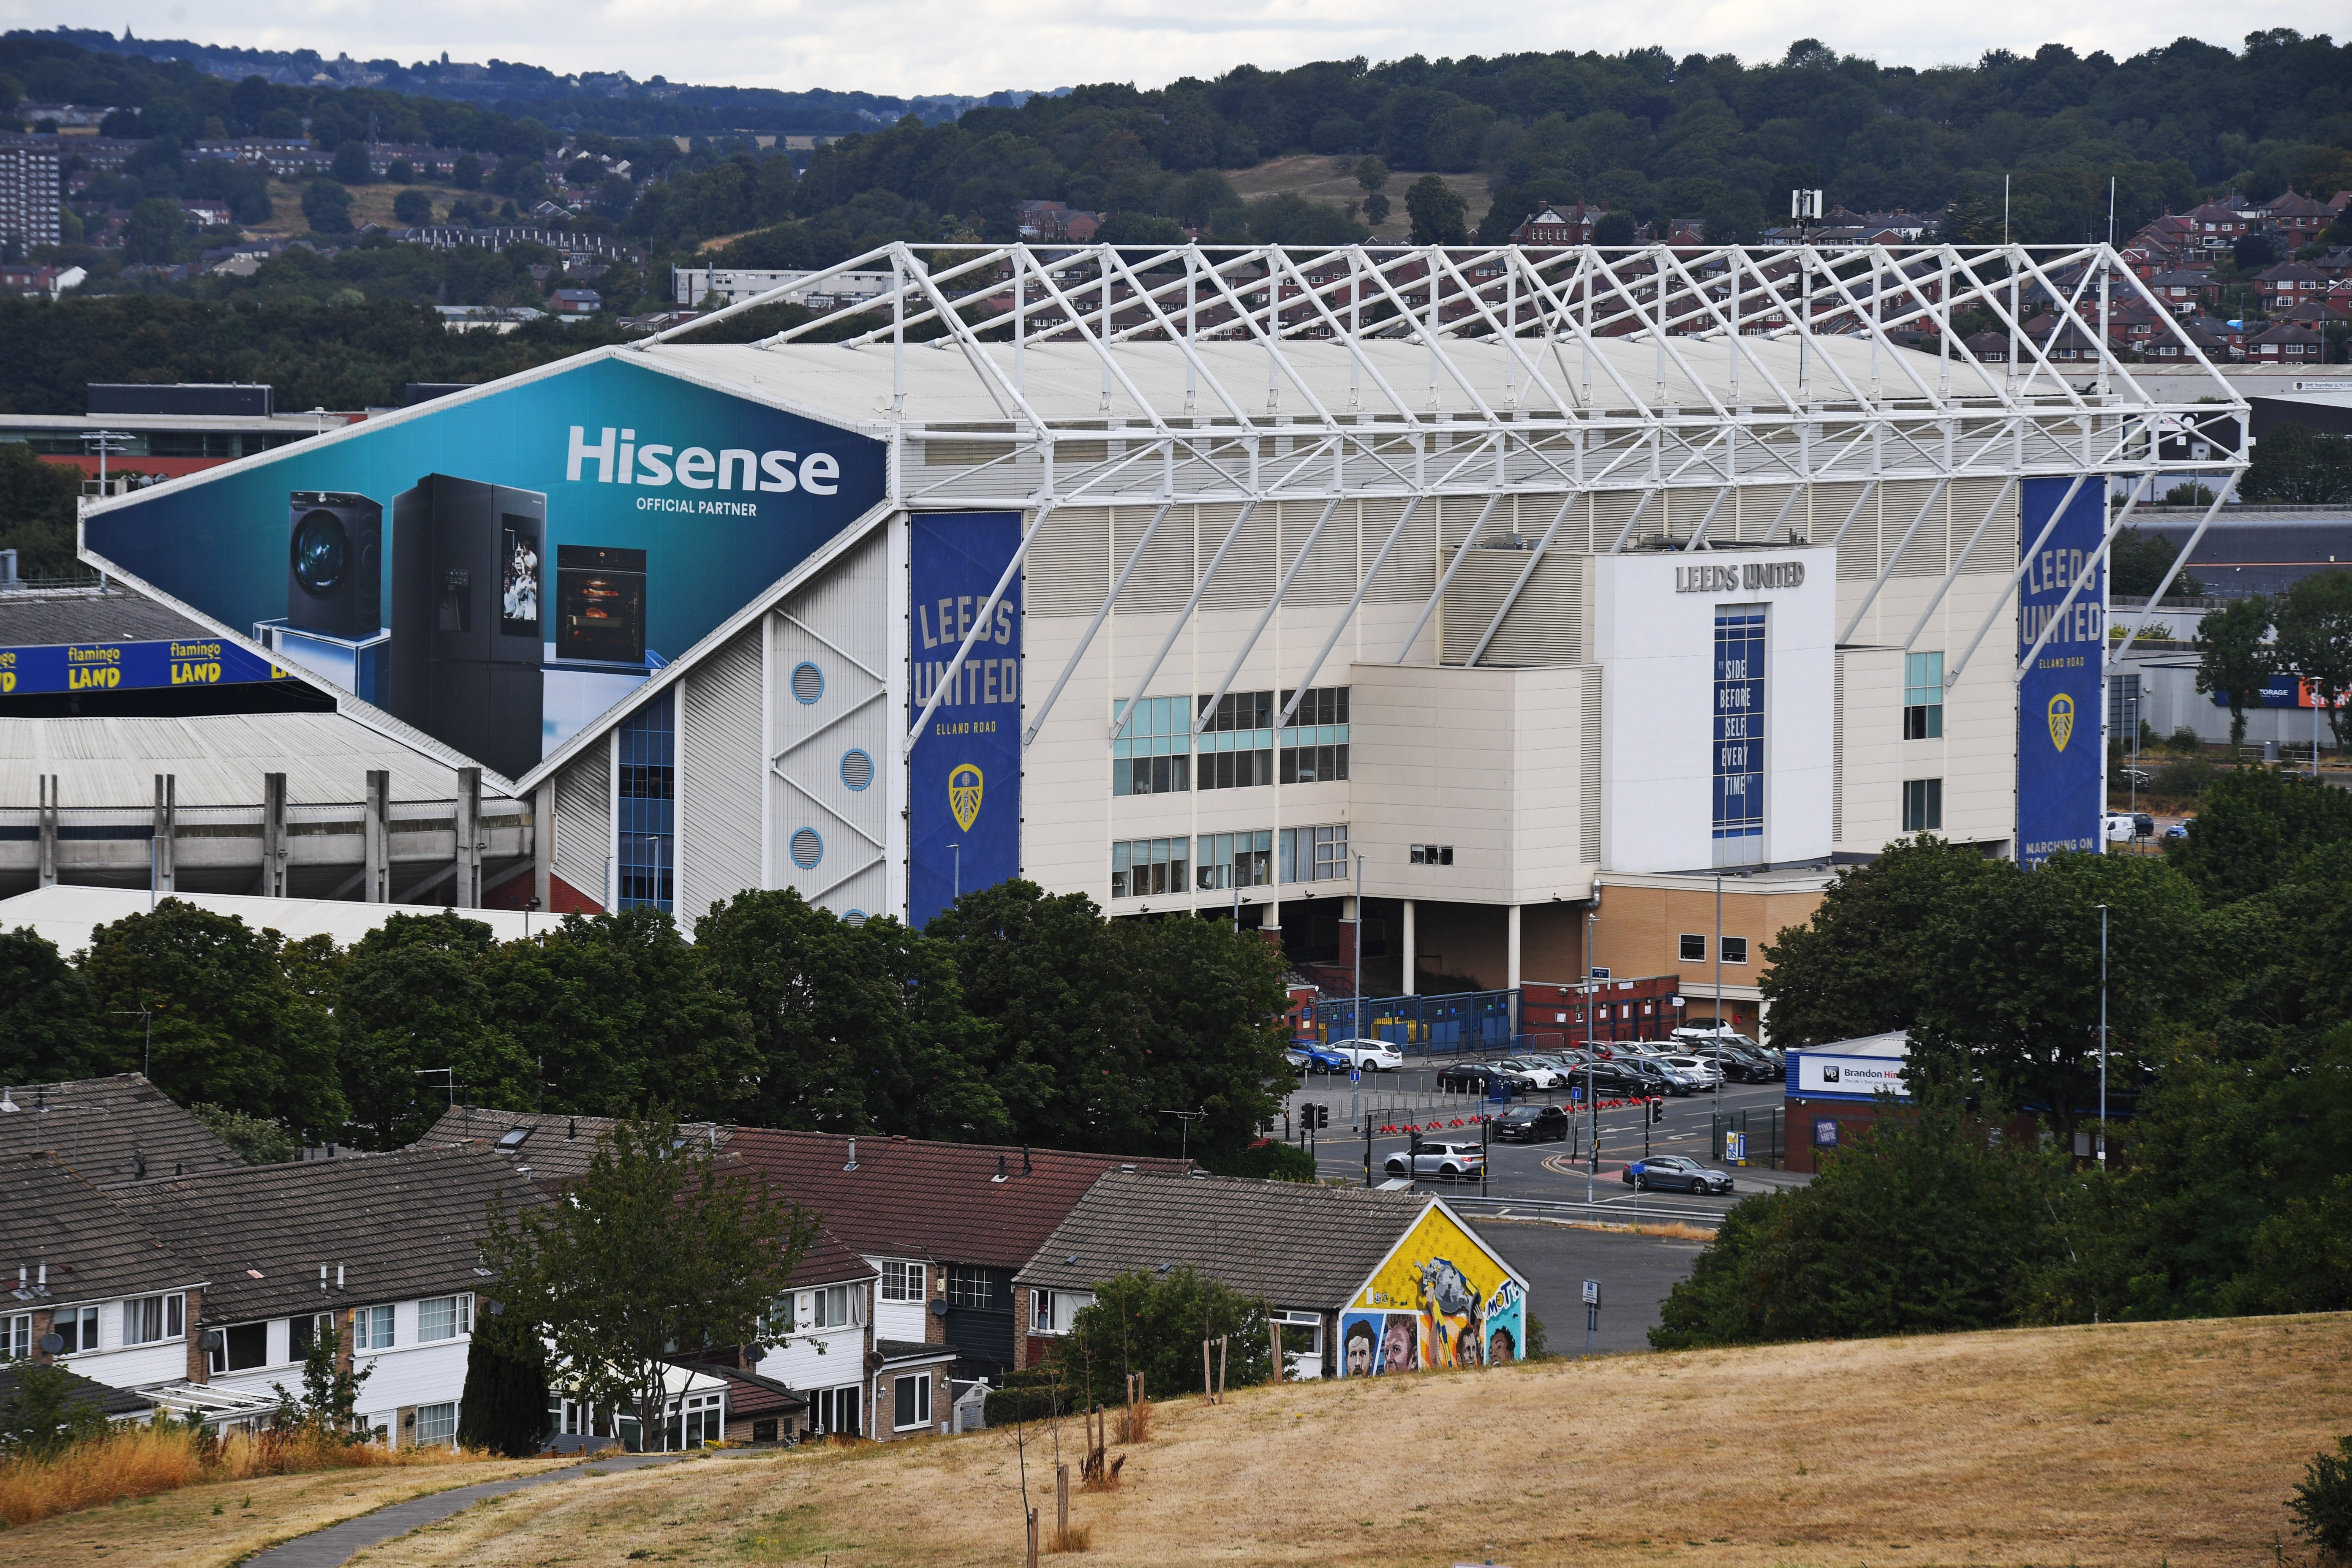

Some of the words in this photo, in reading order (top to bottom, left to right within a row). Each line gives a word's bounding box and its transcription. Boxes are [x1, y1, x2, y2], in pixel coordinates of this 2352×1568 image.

[566, 425, 840, 495] Hisense
[637, 497, 695, 513] OFFICIAL
[698, 501, 757, 516] PARTNER
[1676, 564, 1739, 592] LEEDS
[1743, 562, 1805, 589] UNITED
[2028, 549, 2096, 595] LEEDS
[919, 596, 1014, 649] LEEDS
[2023, 602, 2101, 645] UNITED
[68, 645, 120, 664] flamingo
[170, 640, 220, 659] flamingo
[2039, 658, 2064, 669] ELLAND
[2067, 657, 2085, 667] ROAD
[69, 667, 120, 689] LAND
[171, 663, 220, 684] LAND
[915, 658, 1017, 707] UNITED
[1720, 688, 1750, 708] BEFORE
[936, 722, 969, 735] ELLAND
[974, 721, 996, 733] ROAD
[1722, 746, 1748, 766] EVERY
[2026, 838, 2077, 854] MARCHING
[2080, 837, 2093, 849] ON
[1824, 1068, 1837, 1078] Vp
[1845, 1069, 1882, 1078] Brandon
[1884, 1070, 1897, 1078] Hir
[1817, 1122, 1835, 1133] TOOL
[1821, 1131, 1836, 1142] HIRE
